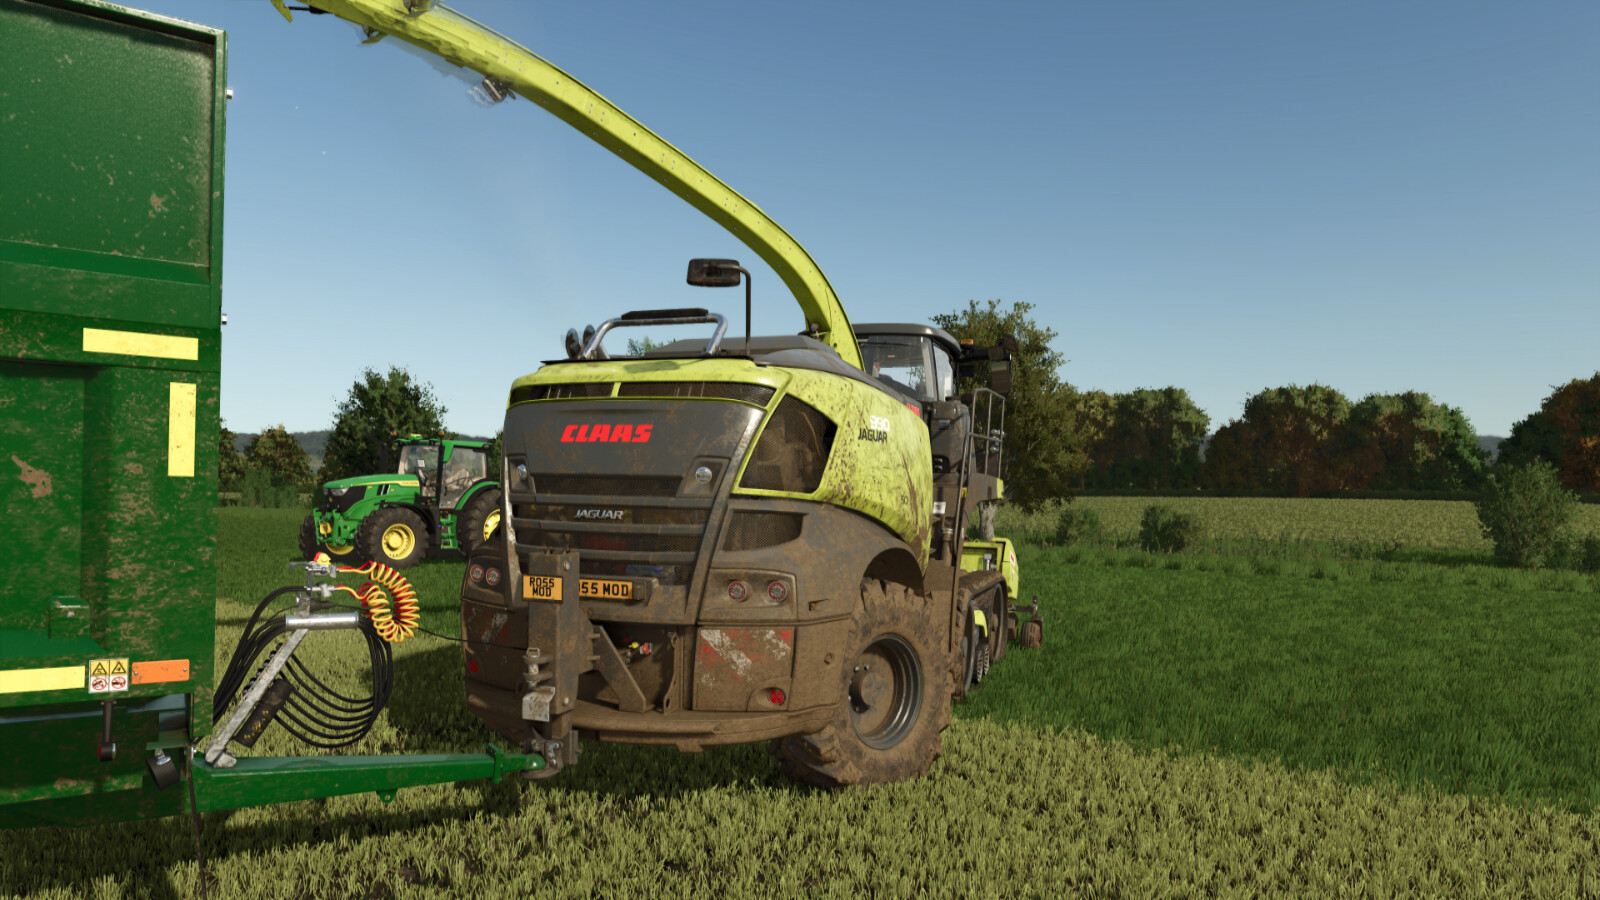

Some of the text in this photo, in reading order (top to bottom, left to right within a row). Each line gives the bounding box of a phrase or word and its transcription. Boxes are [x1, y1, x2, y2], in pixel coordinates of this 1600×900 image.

[560, 424, 653, 443] CLAAS
[858, 427, 888, 443] JAGUAR
[574, 509, 624, 520] JAGUAR
[532, 587, 552, 597] MOD
[579, 581, 629, 597] 55 MOD
